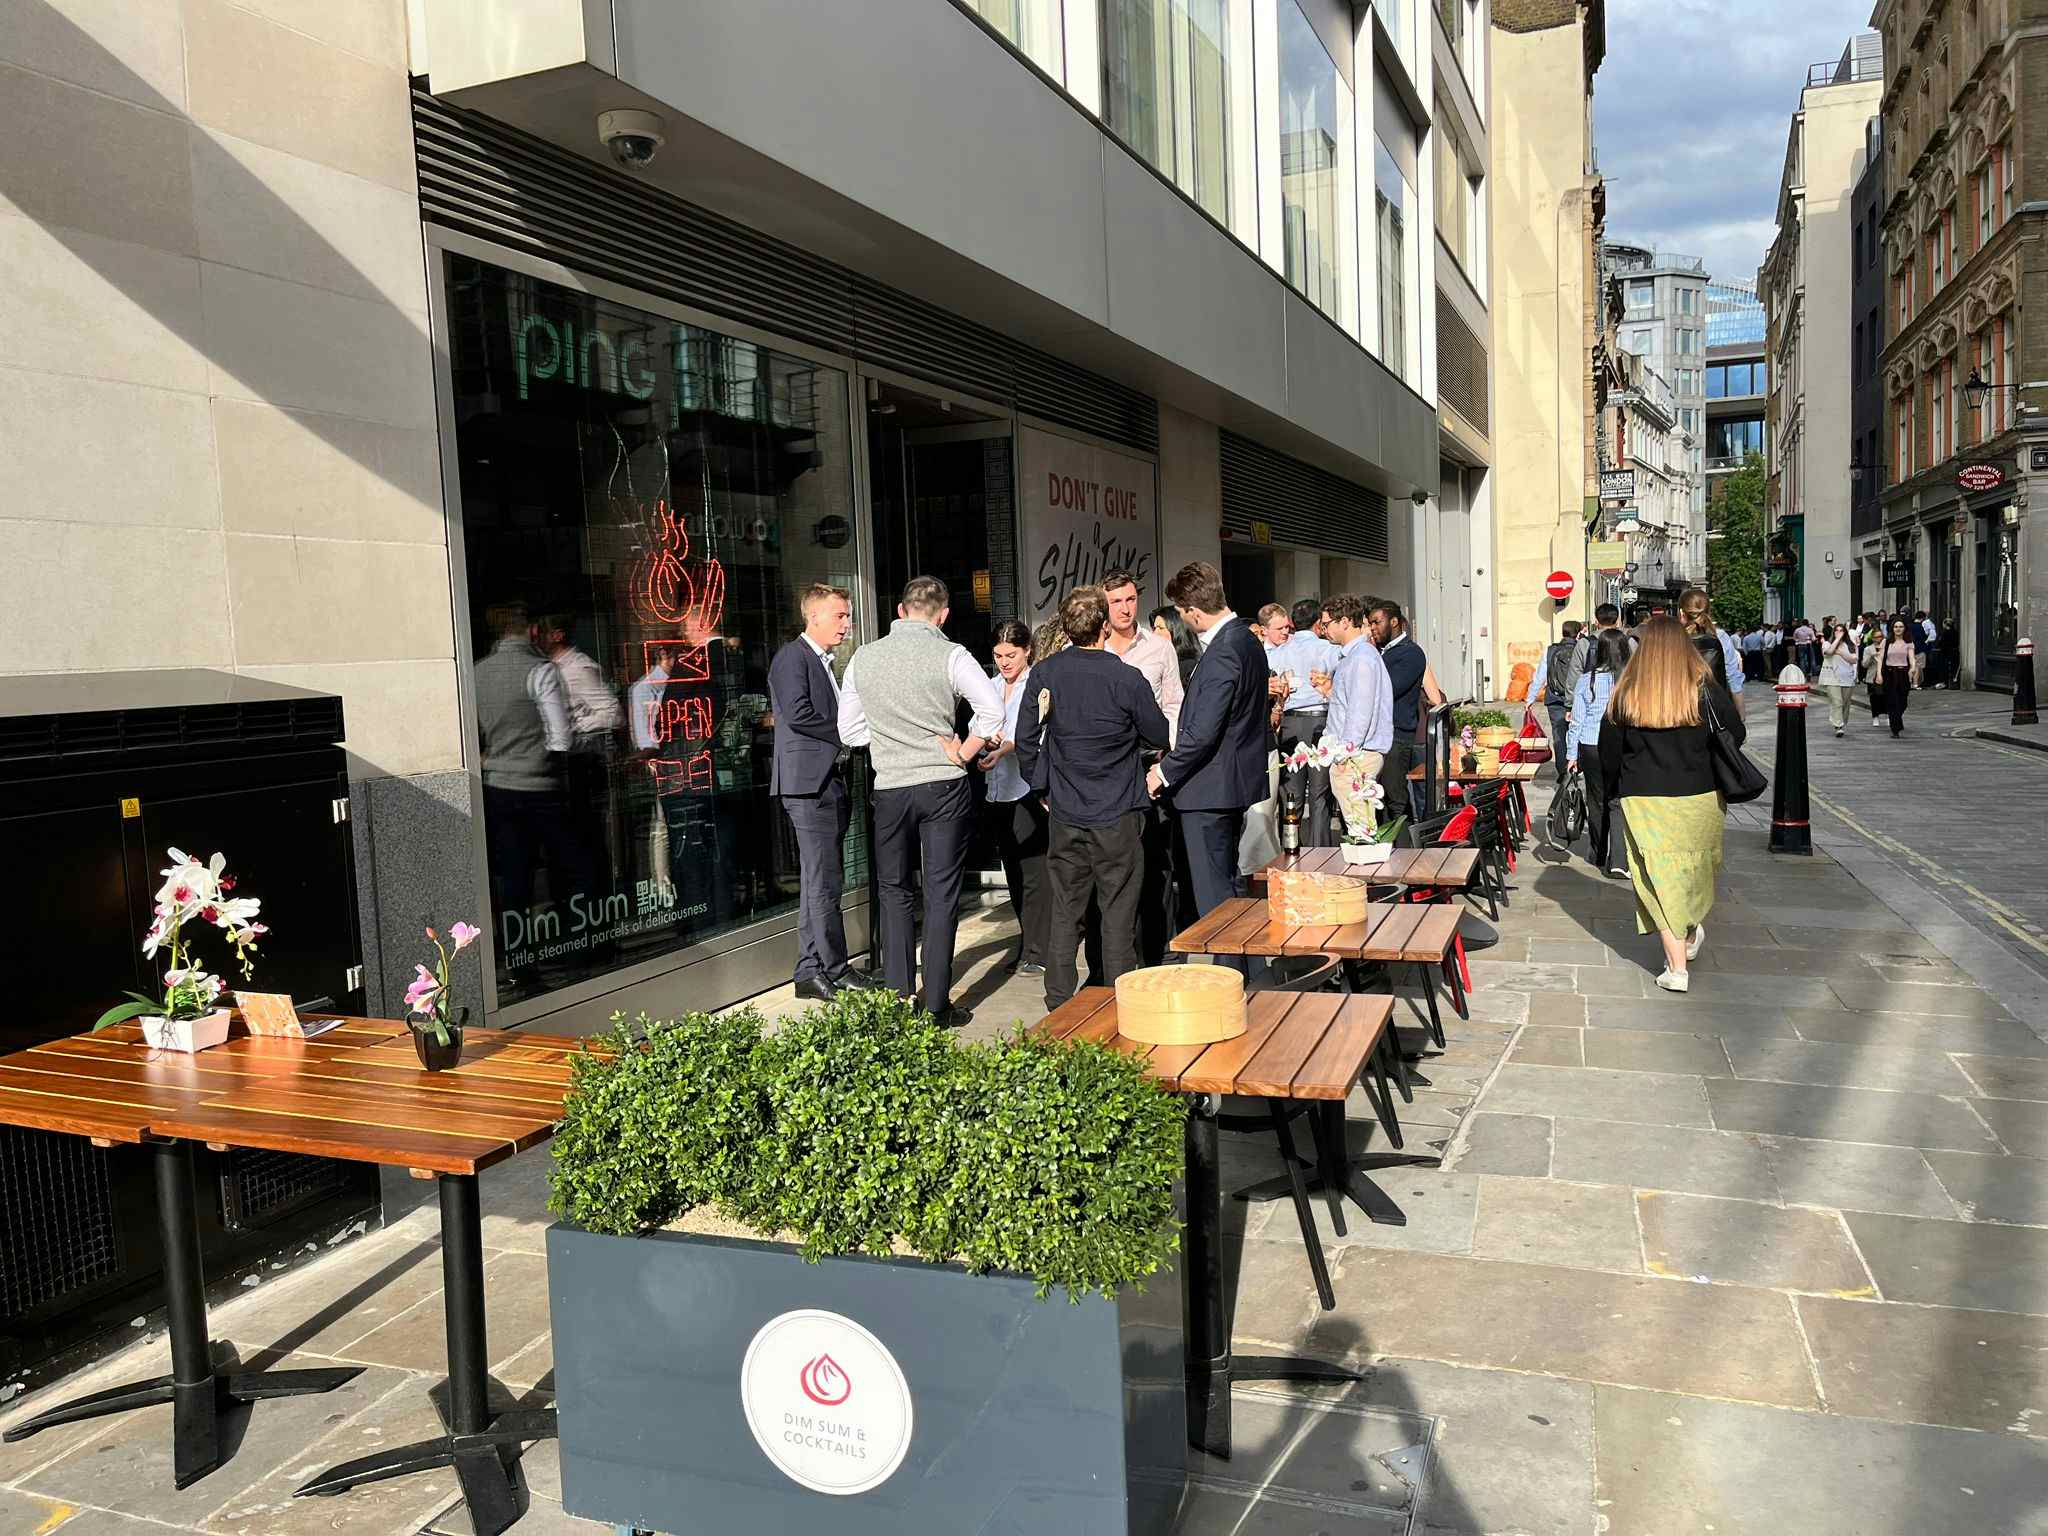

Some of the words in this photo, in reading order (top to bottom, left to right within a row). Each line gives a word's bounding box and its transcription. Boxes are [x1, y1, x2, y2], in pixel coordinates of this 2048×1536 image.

[1601, 477, 1633, 487] LONDON
[1959, 465, 2001, 478] CONTINENTAL
[1048, 472, 1100, 514] DON'T
[1104, 486, 1138, 521] GIVE
[648, 696, 713, 744] OPEN
[502, 907, 560, 950] Dim
[569, 892, 629, 933] Sum
[505, 949, 535, 970] Little
[538, 932, 588, 961] steamed
[591, 921, 630, 949] parcels
[632, 916, 643, 933] of
[645, 901, 709, 929] deliciousness
[783, 1430, 867, 1460] COCKTAILS
[784, 1412, 813, 1432] DIM
[818, 1420, 851, 1438] SUM
[857, 1428, 867, 1442] &
